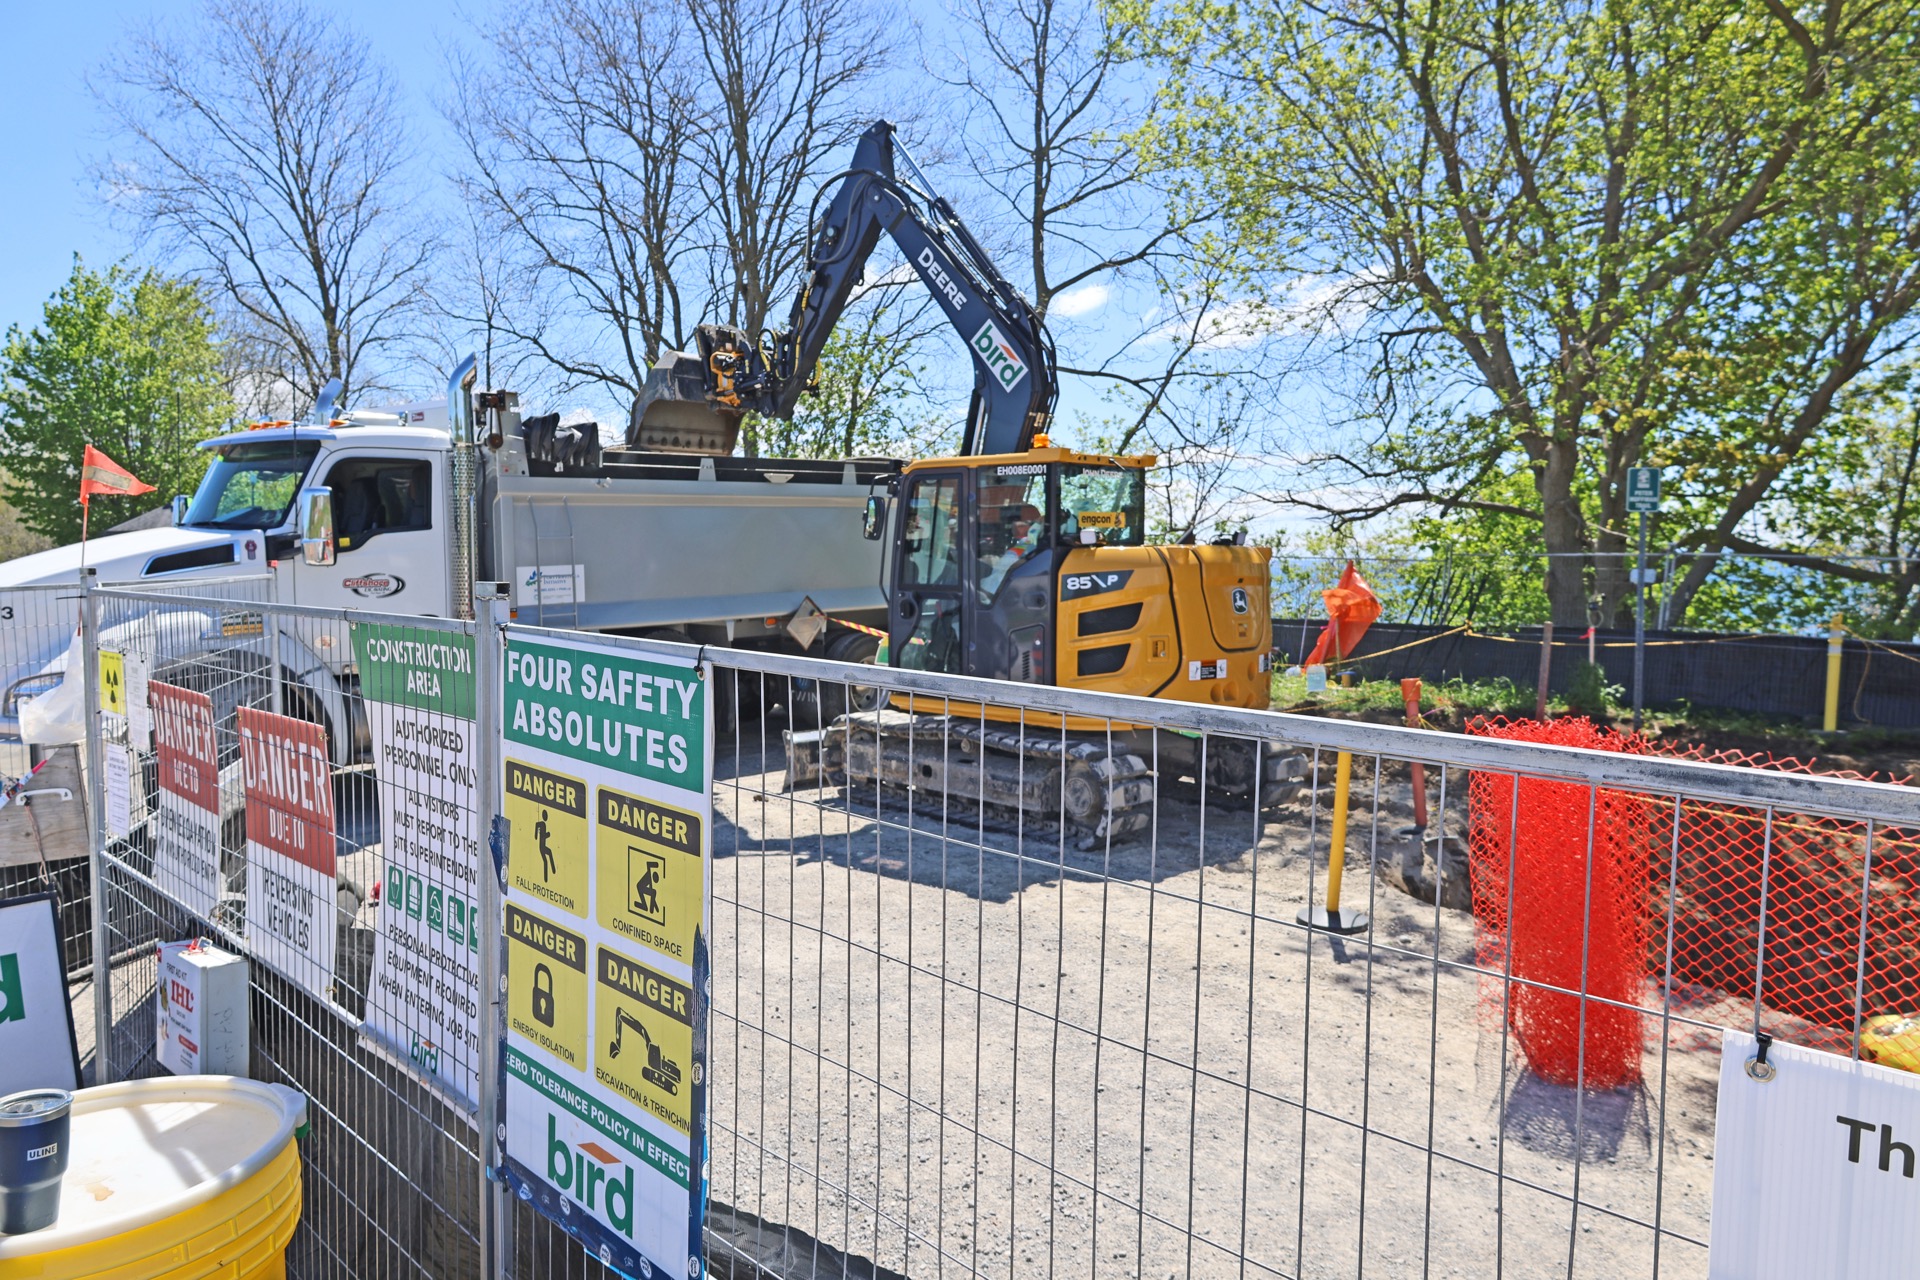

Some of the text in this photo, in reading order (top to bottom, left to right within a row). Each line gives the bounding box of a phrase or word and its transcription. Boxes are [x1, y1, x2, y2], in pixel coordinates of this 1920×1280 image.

[917, 246, 968, 311] DEERE
[975, 323, 1025, 387] bird
[1081, 514, 1111, 526] engcon
[1, 606, 14, 620] 3
[366, 638, 472, 674] CONSTRUCTION
[407, 669, 442, 698] AREA
[508, 650, 698, 720] FOUR SAFETY
[150, 691, 215, 767] DANGER
[395, 719, 464, 754] AUTHORIZED
[512, 699, 689, 774] ABSOLUTES
[241, 727, 330, 818] DANGER
[384, 744, 447, 780] PERSONNEL
[408, 790, 460, 822] ALL VISITORS
[513, 769, 577, 809] DANGER
[269, 807, 306, 851] DUE TO
[394, 809, 478, 858] MUST REPORT TO THE
[608, 798, 688, 845] DANGER
[394, 834, 408, 854] SITE
[409, 843, 478, 886] SUPERINTENDEN
[264, 867, 314, 919] REVERSING
[516, 875, 575, 911] FALL PROTECTION
[267, 901, 310, 952] VEHICLES
[513, 913, 577, 963] DANGER
[612, 917, 683, 957] CONFINED SPACE
[389, 923, 429, 960] PERSONAL
[431, 948, 479, 992] PROTECTIVE
[378, 971, 403, 1000] WHEN
[405, 988, 445, 1026] ENTERING
[446, 1016, 463, 1040] JOB
[387, 950, 434, 988] EQUIPMENT
[435, 979, 477, 1019] REQUIRED
[607, 958, 686, 1017] DANGER
[410, 1031, 440, 1075] bird
[513, 1017, 575, 1063] ENERGY ISOLATION
[596, 1067, 642, 1103] EXCAVATION
[643, 1096, 649, 1108] &
[530, 1066, 588, 1116] TOLERANCE
[590, 1104, 630, 1141] POLICY
[632, 1131, 645, 1152] IN
[647, 1141, 690, 1182] EFFECT
[1836, 1115, 1915, 1179] Th
[29, 1144, 56, 1159] ULINE
[547, 1112, 635, 1240] bird
